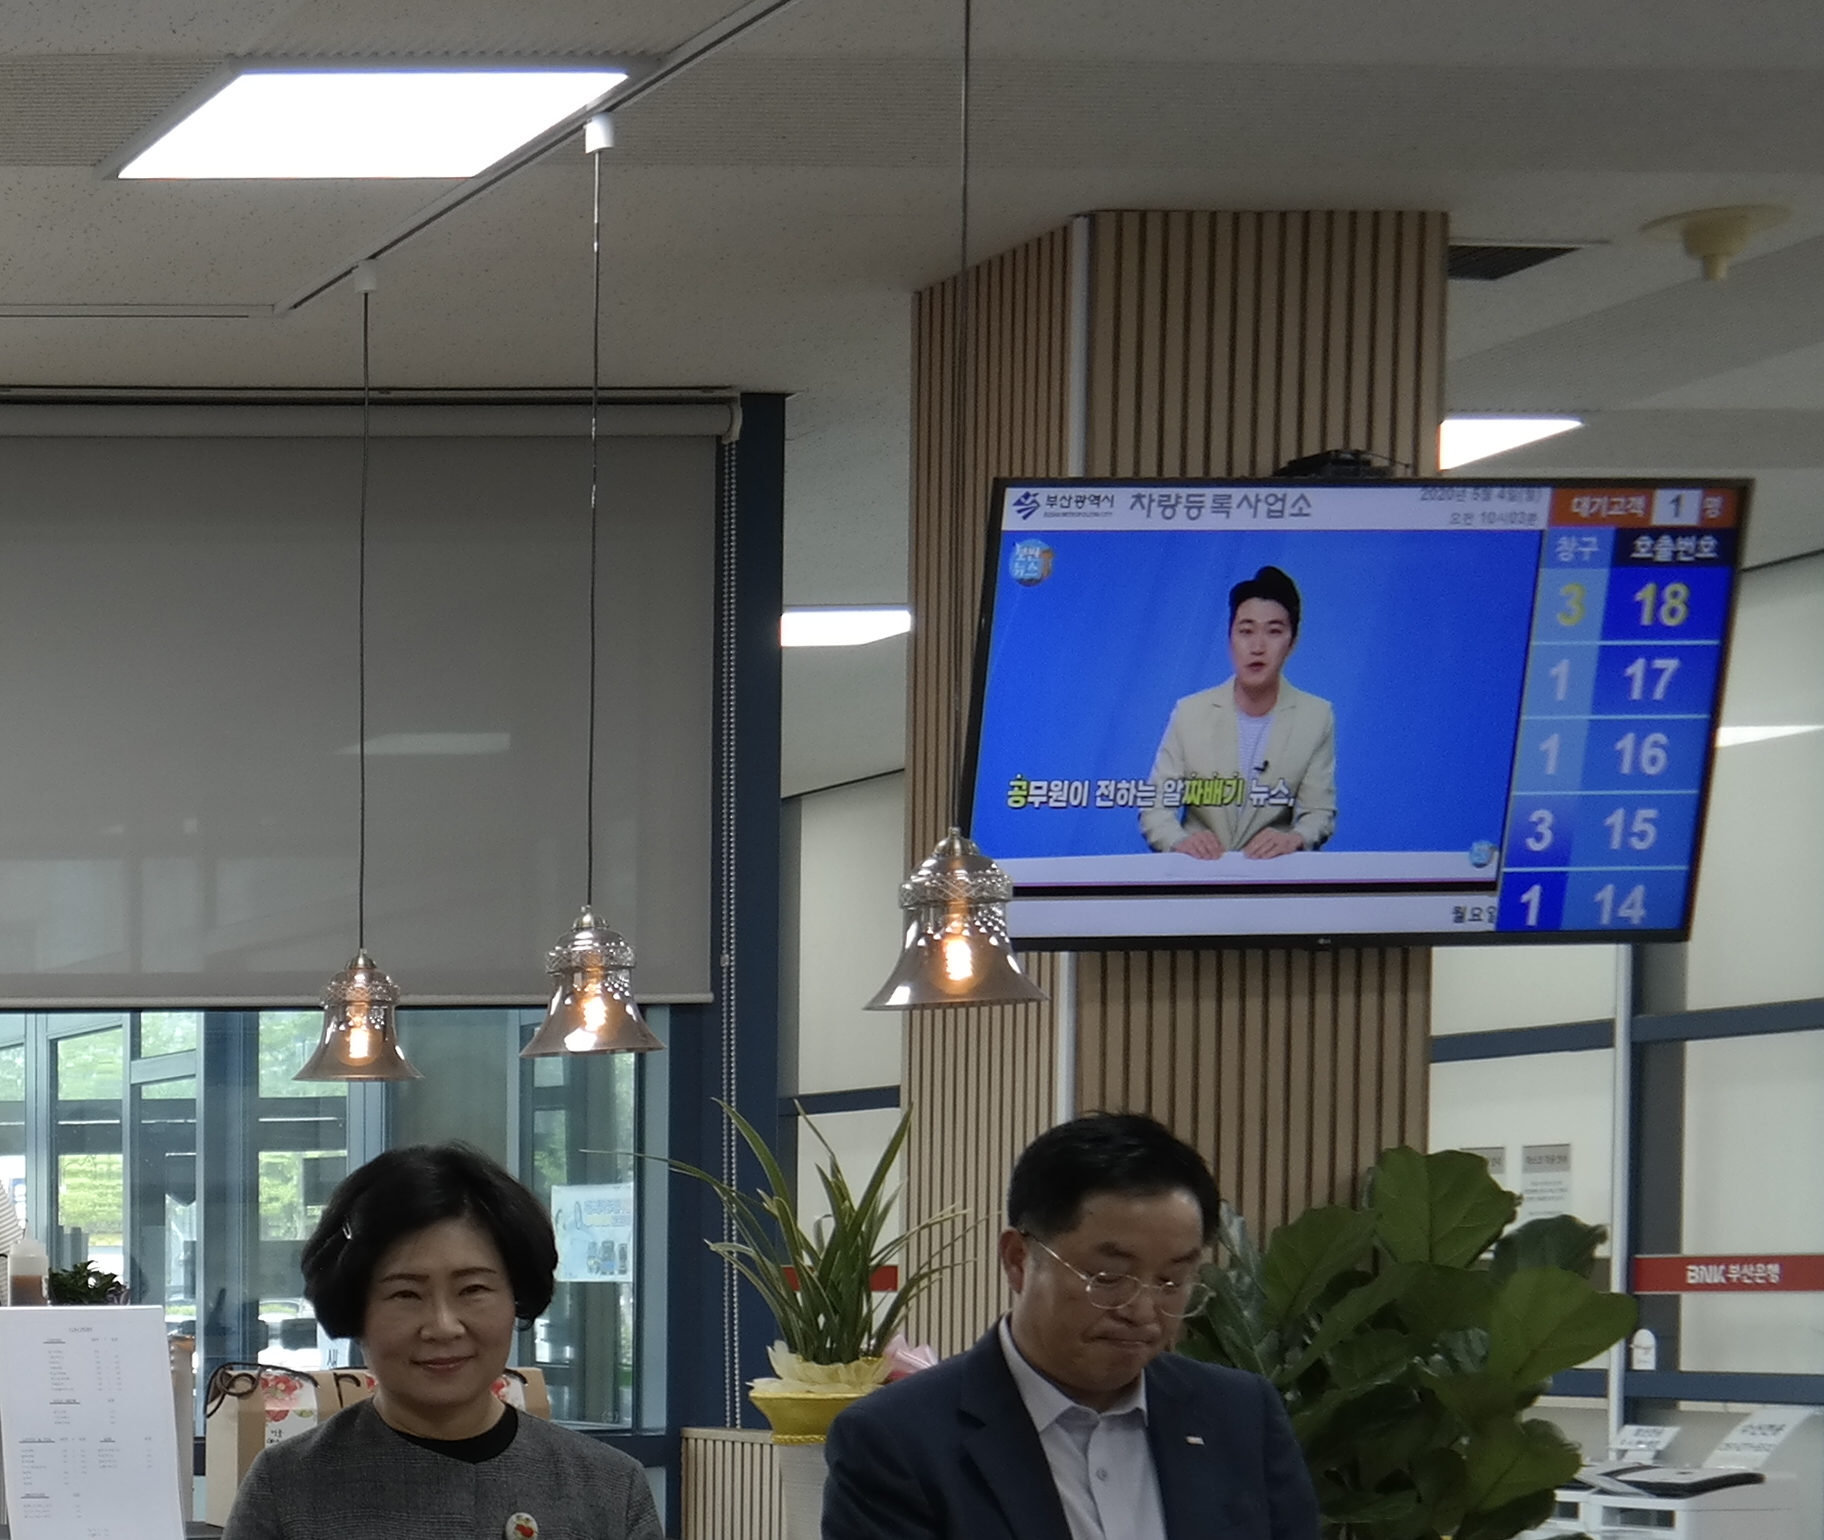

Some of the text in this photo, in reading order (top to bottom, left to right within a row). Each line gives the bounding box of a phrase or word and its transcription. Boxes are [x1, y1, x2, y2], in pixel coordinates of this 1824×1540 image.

[1045, 493, 1115, 509] 부산광역시
[1129, 492, 1313, 521] 차량등록사업소
[1570, 493, 1723, 518] 대기고객 1 명
[1556, 537, 1600, 562] 창구
[1630, 536, 1719, 562] 호출번호
[1557, 583, 1586, 626] 3
[1634, 582, 1690, 626] 18
[1550, 659, 1571, 701] 1
[1624, 658, 1681, 700] 17
[1539, 733, 1560, 775] 1
[1614, 732, 1669, 776] 16
[1007, 779, 1089, 808] 공무원이
[1095, 779, 1155, 808] 전하는
[1163, 778, 1245, 808] 알짜배기
[1525, 809, 1553, 851] 3
[1604, 808, 1659, 850] 15
[1520, 884, 1542, 926] 1
[1594, 884, 1646, 926] 14
[1686, 1263, 1781, 1284] BNK 부산은행
